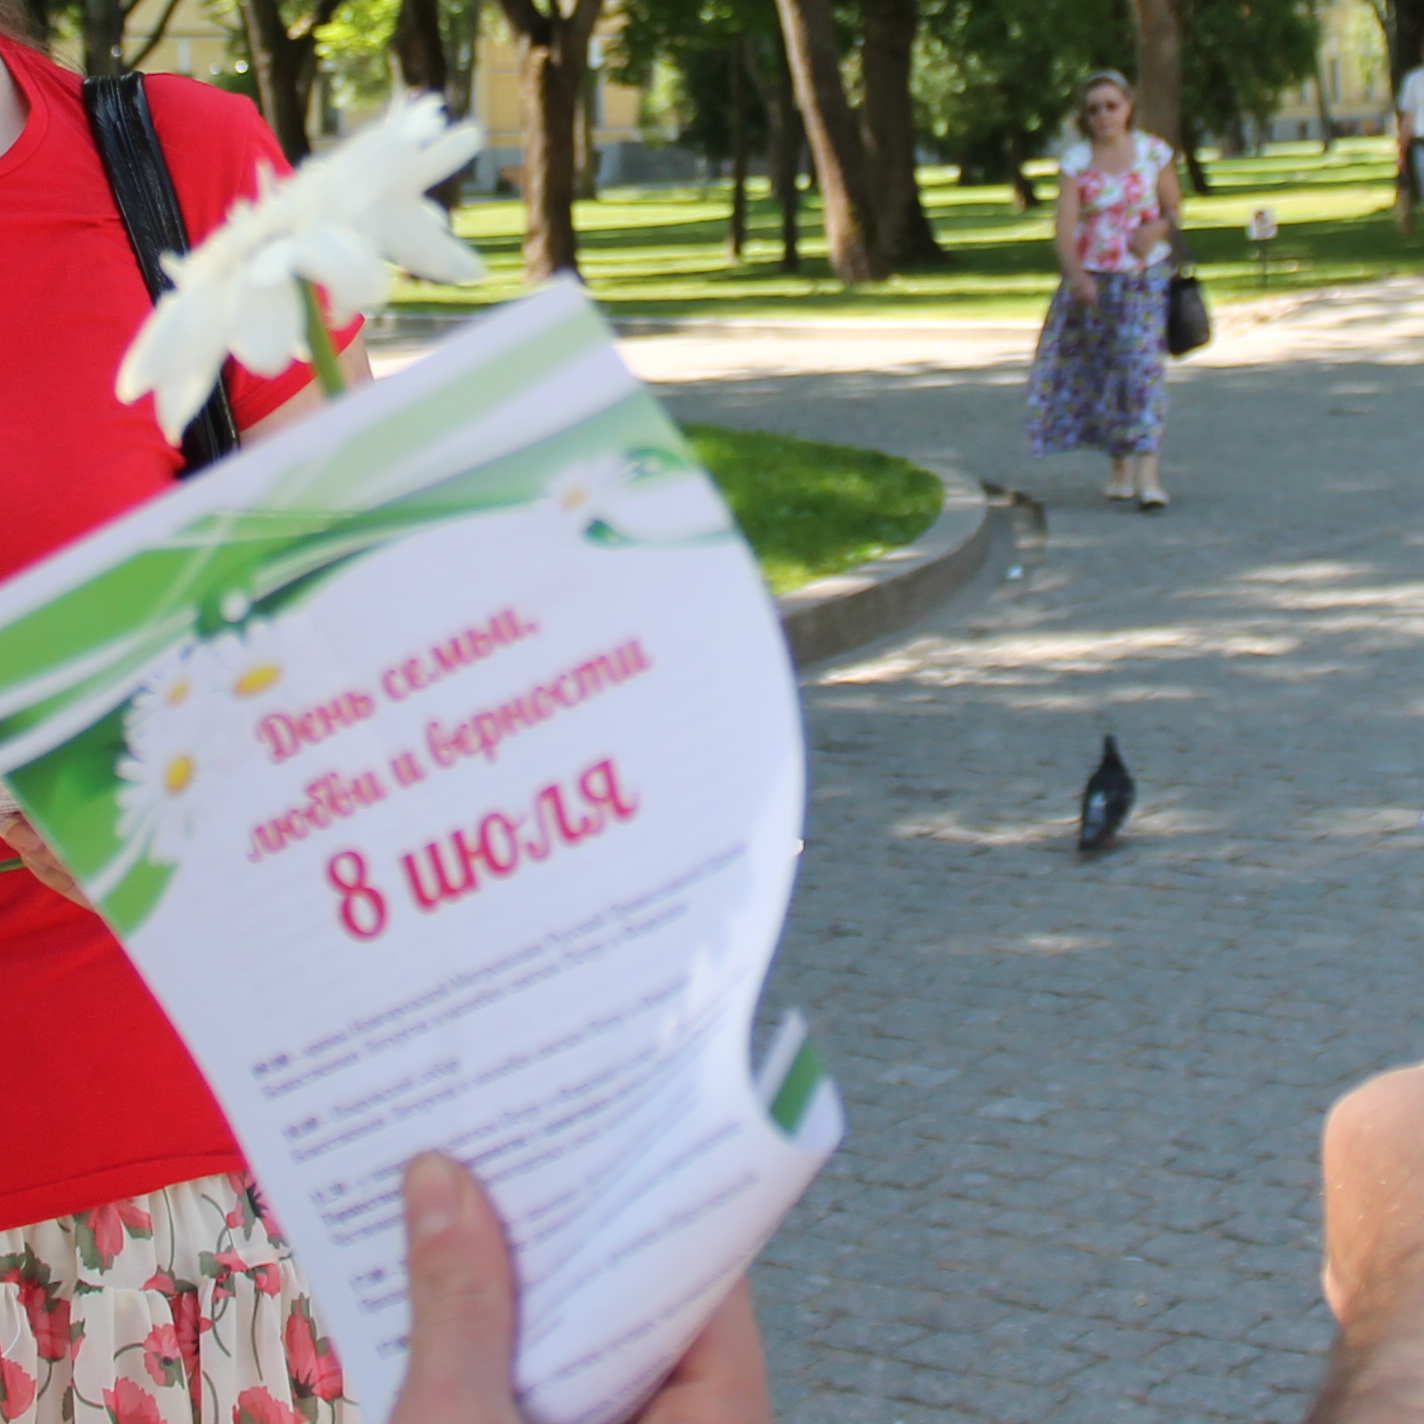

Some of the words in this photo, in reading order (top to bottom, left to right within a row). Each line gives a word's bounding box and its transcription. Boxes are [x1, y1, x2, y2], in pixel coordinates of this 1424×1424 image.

[247, 772, 388, 862] любви
[389, 752, 429, 789] и
[426, 639, 652, 768] верности
[257, 691, 375, 763] День
[326, 849, 389, 941] 8
[400, 759, 641, 912] июля
